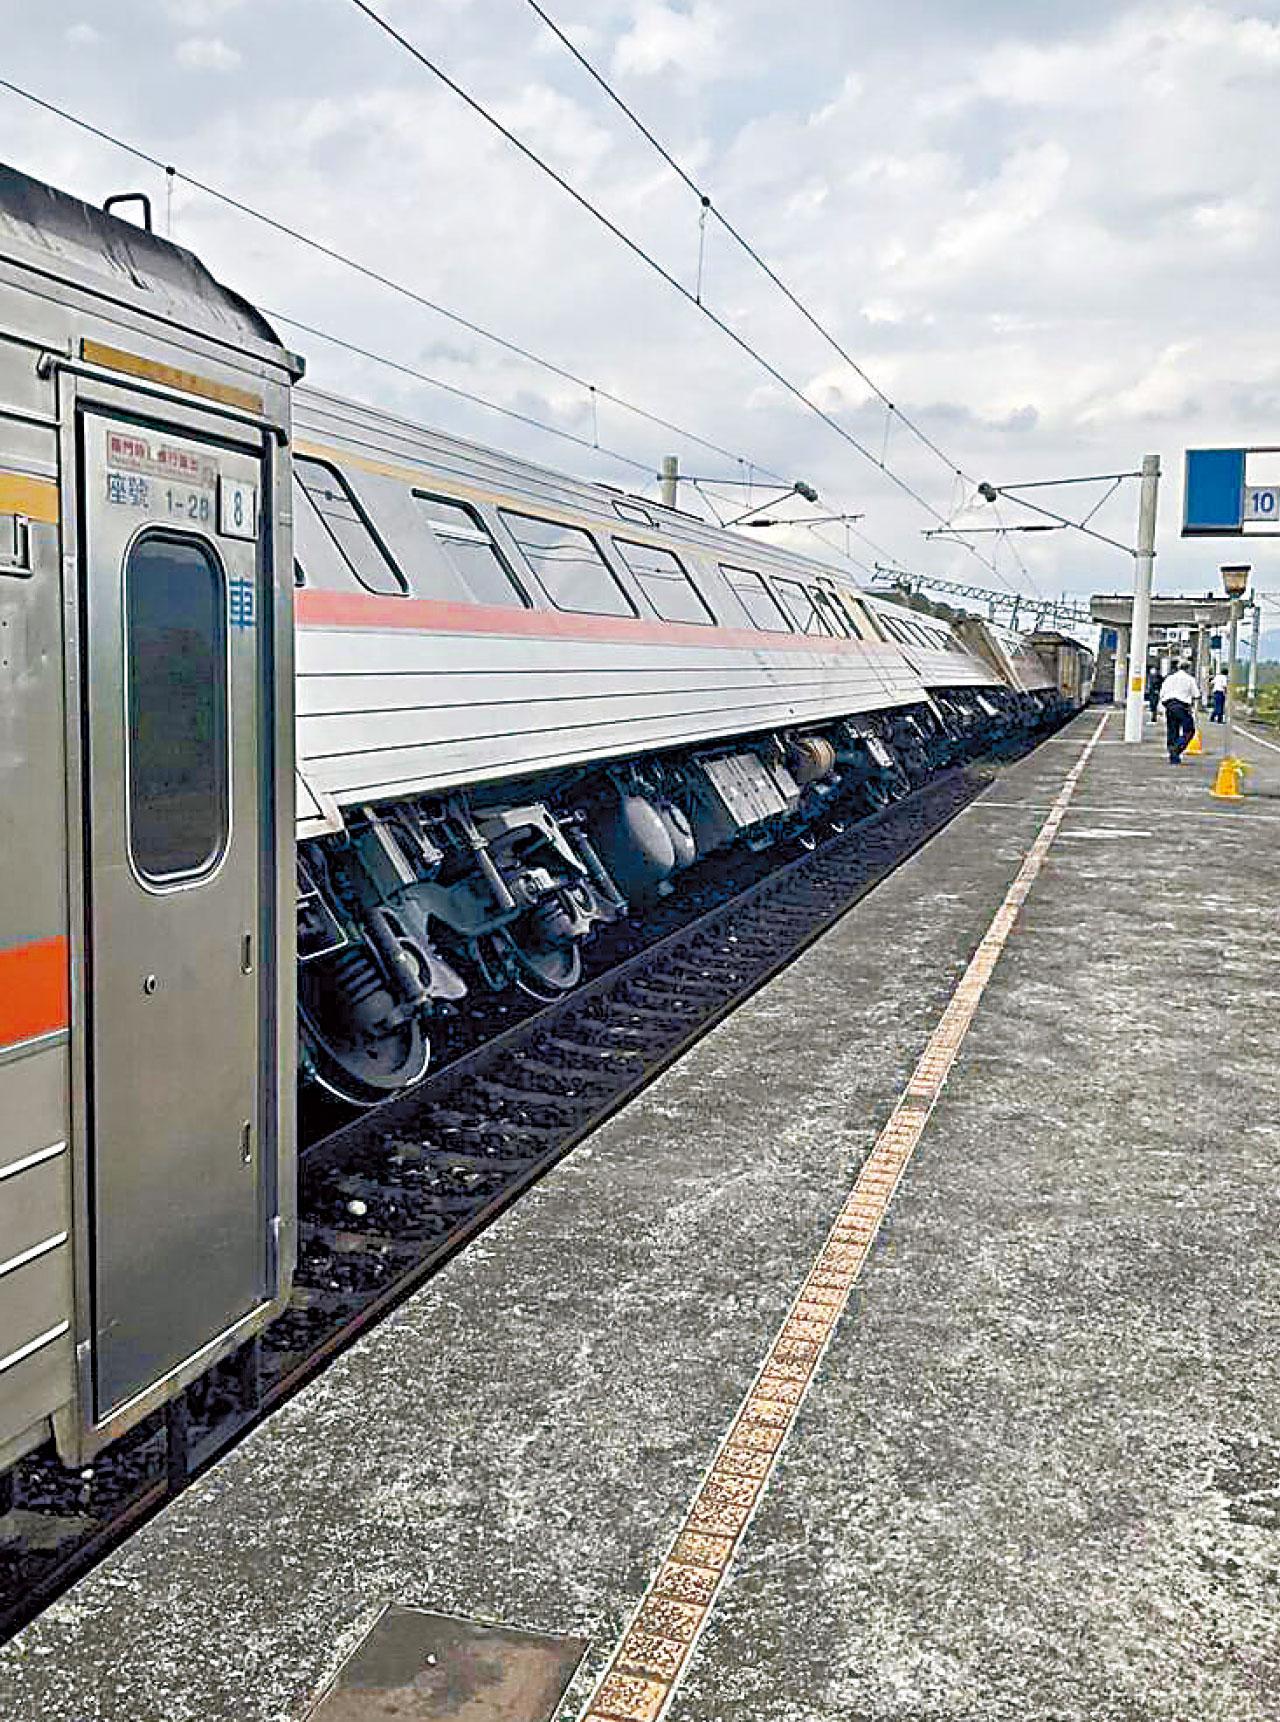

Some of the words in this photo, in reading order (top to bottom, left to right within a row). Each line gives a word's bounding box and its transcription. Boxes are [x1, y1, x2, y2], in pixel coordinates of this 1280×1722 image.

[167, 488, 209, 522] 1-28
[233, 491, 243, 527] 8
[1252, 492, 1275, 512] 10
[228, 577, 256, 633] 車
